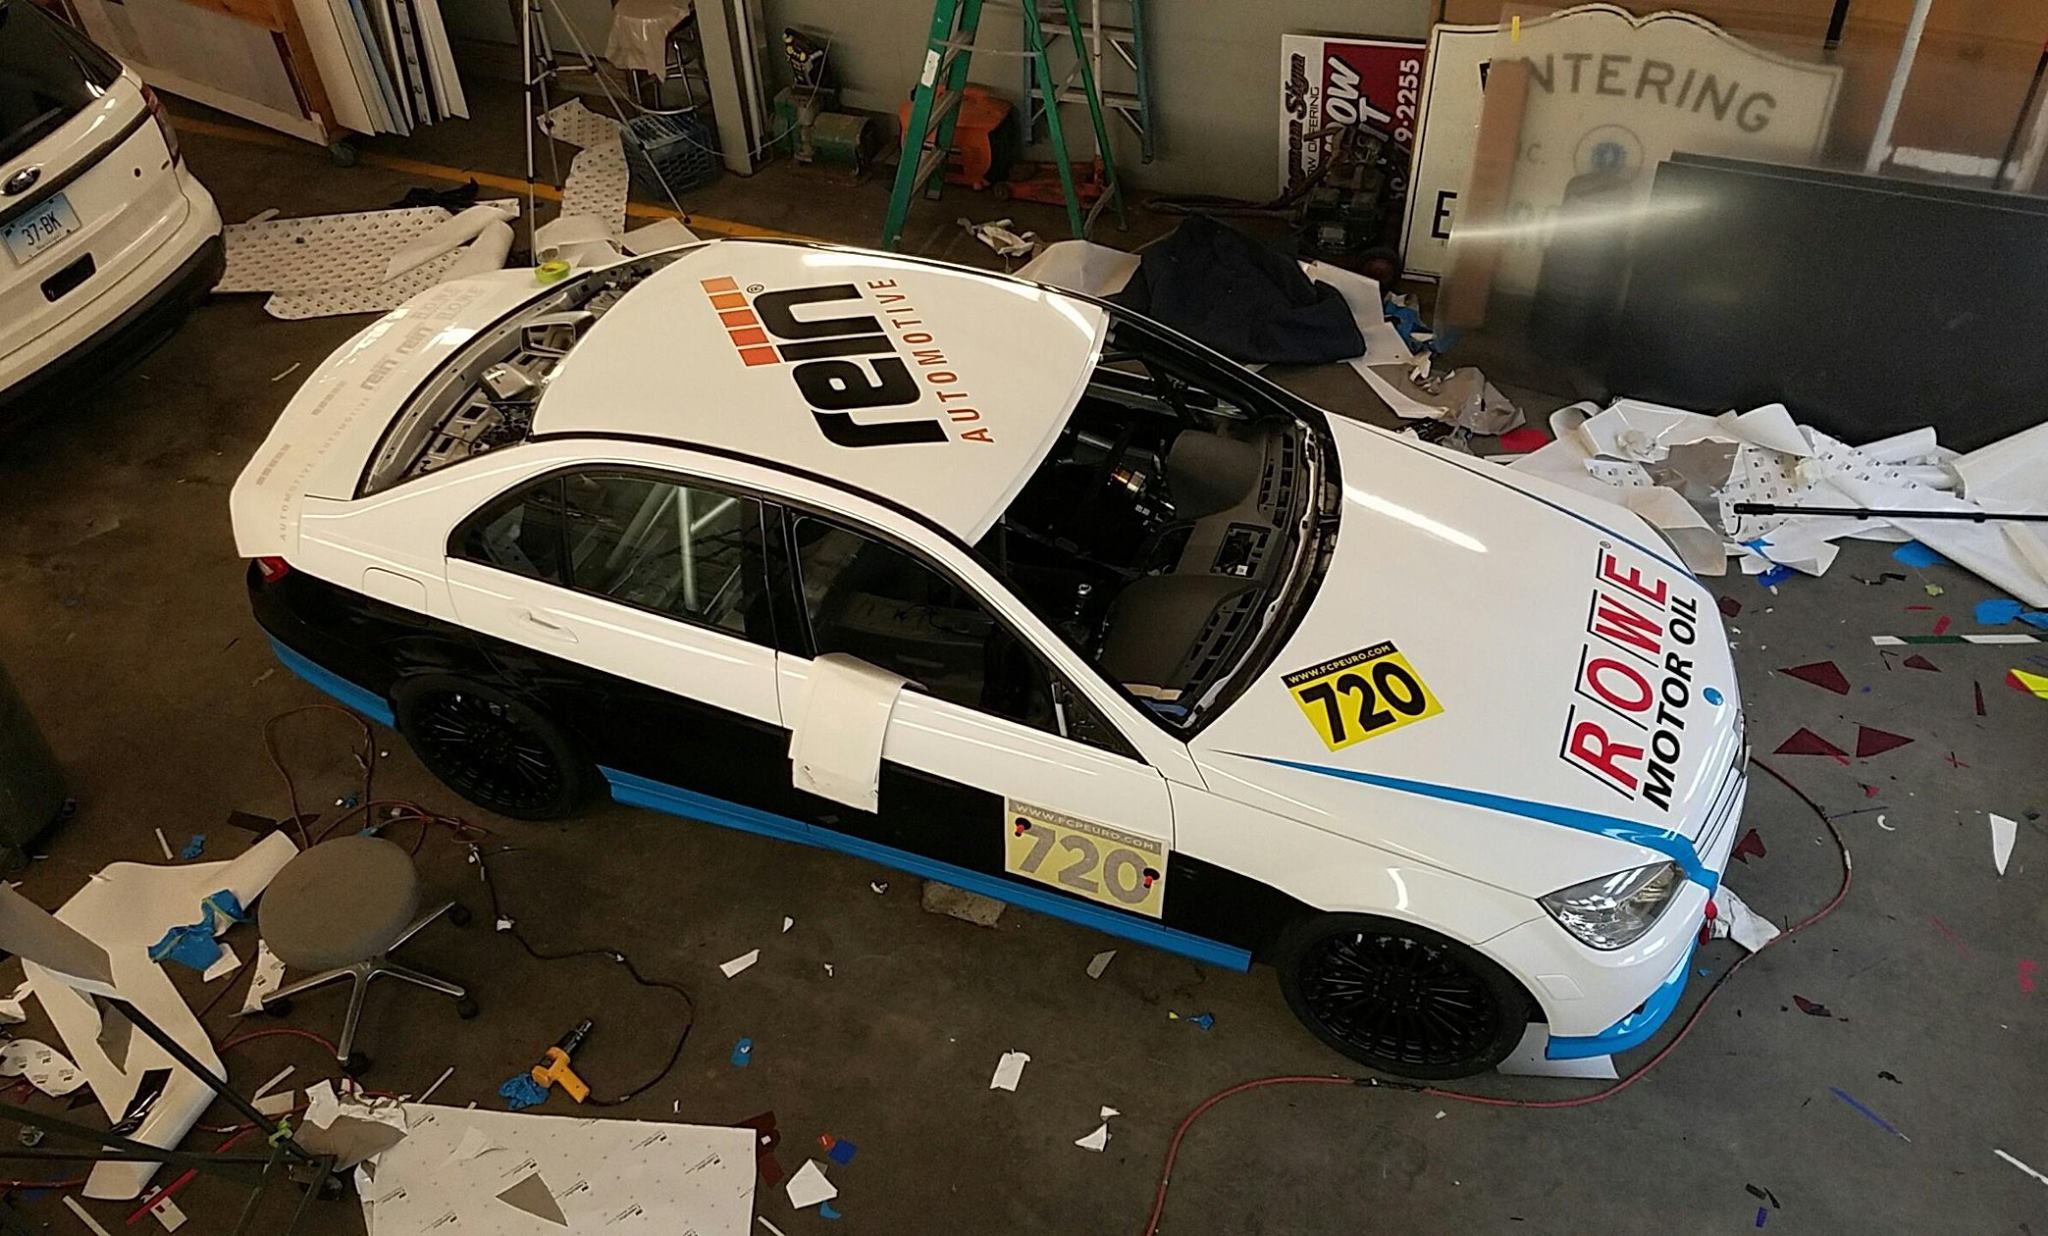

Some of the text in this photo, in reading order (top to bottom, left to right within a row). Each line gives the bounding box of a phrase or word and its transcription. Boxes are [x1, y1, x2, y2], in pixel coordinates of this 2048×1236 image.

[1479, 53, 1777, 133] NTERING
[753, 283, 950, 448] rein
[867, 278, 995, 443] AUTOMOTIVE
[1288, 645, 1392, 684] WWW.FCPEURO.COM
[1297, 661, 1427, 744] 720
[1569, 554, 1668, 792] ROWE
[1642, 595, 1697, 813] MOTOR OIL
[1015, 803, 1154, 850] WWW.FCPEURO.COM
[1016, 822, 1153, 905] 720
